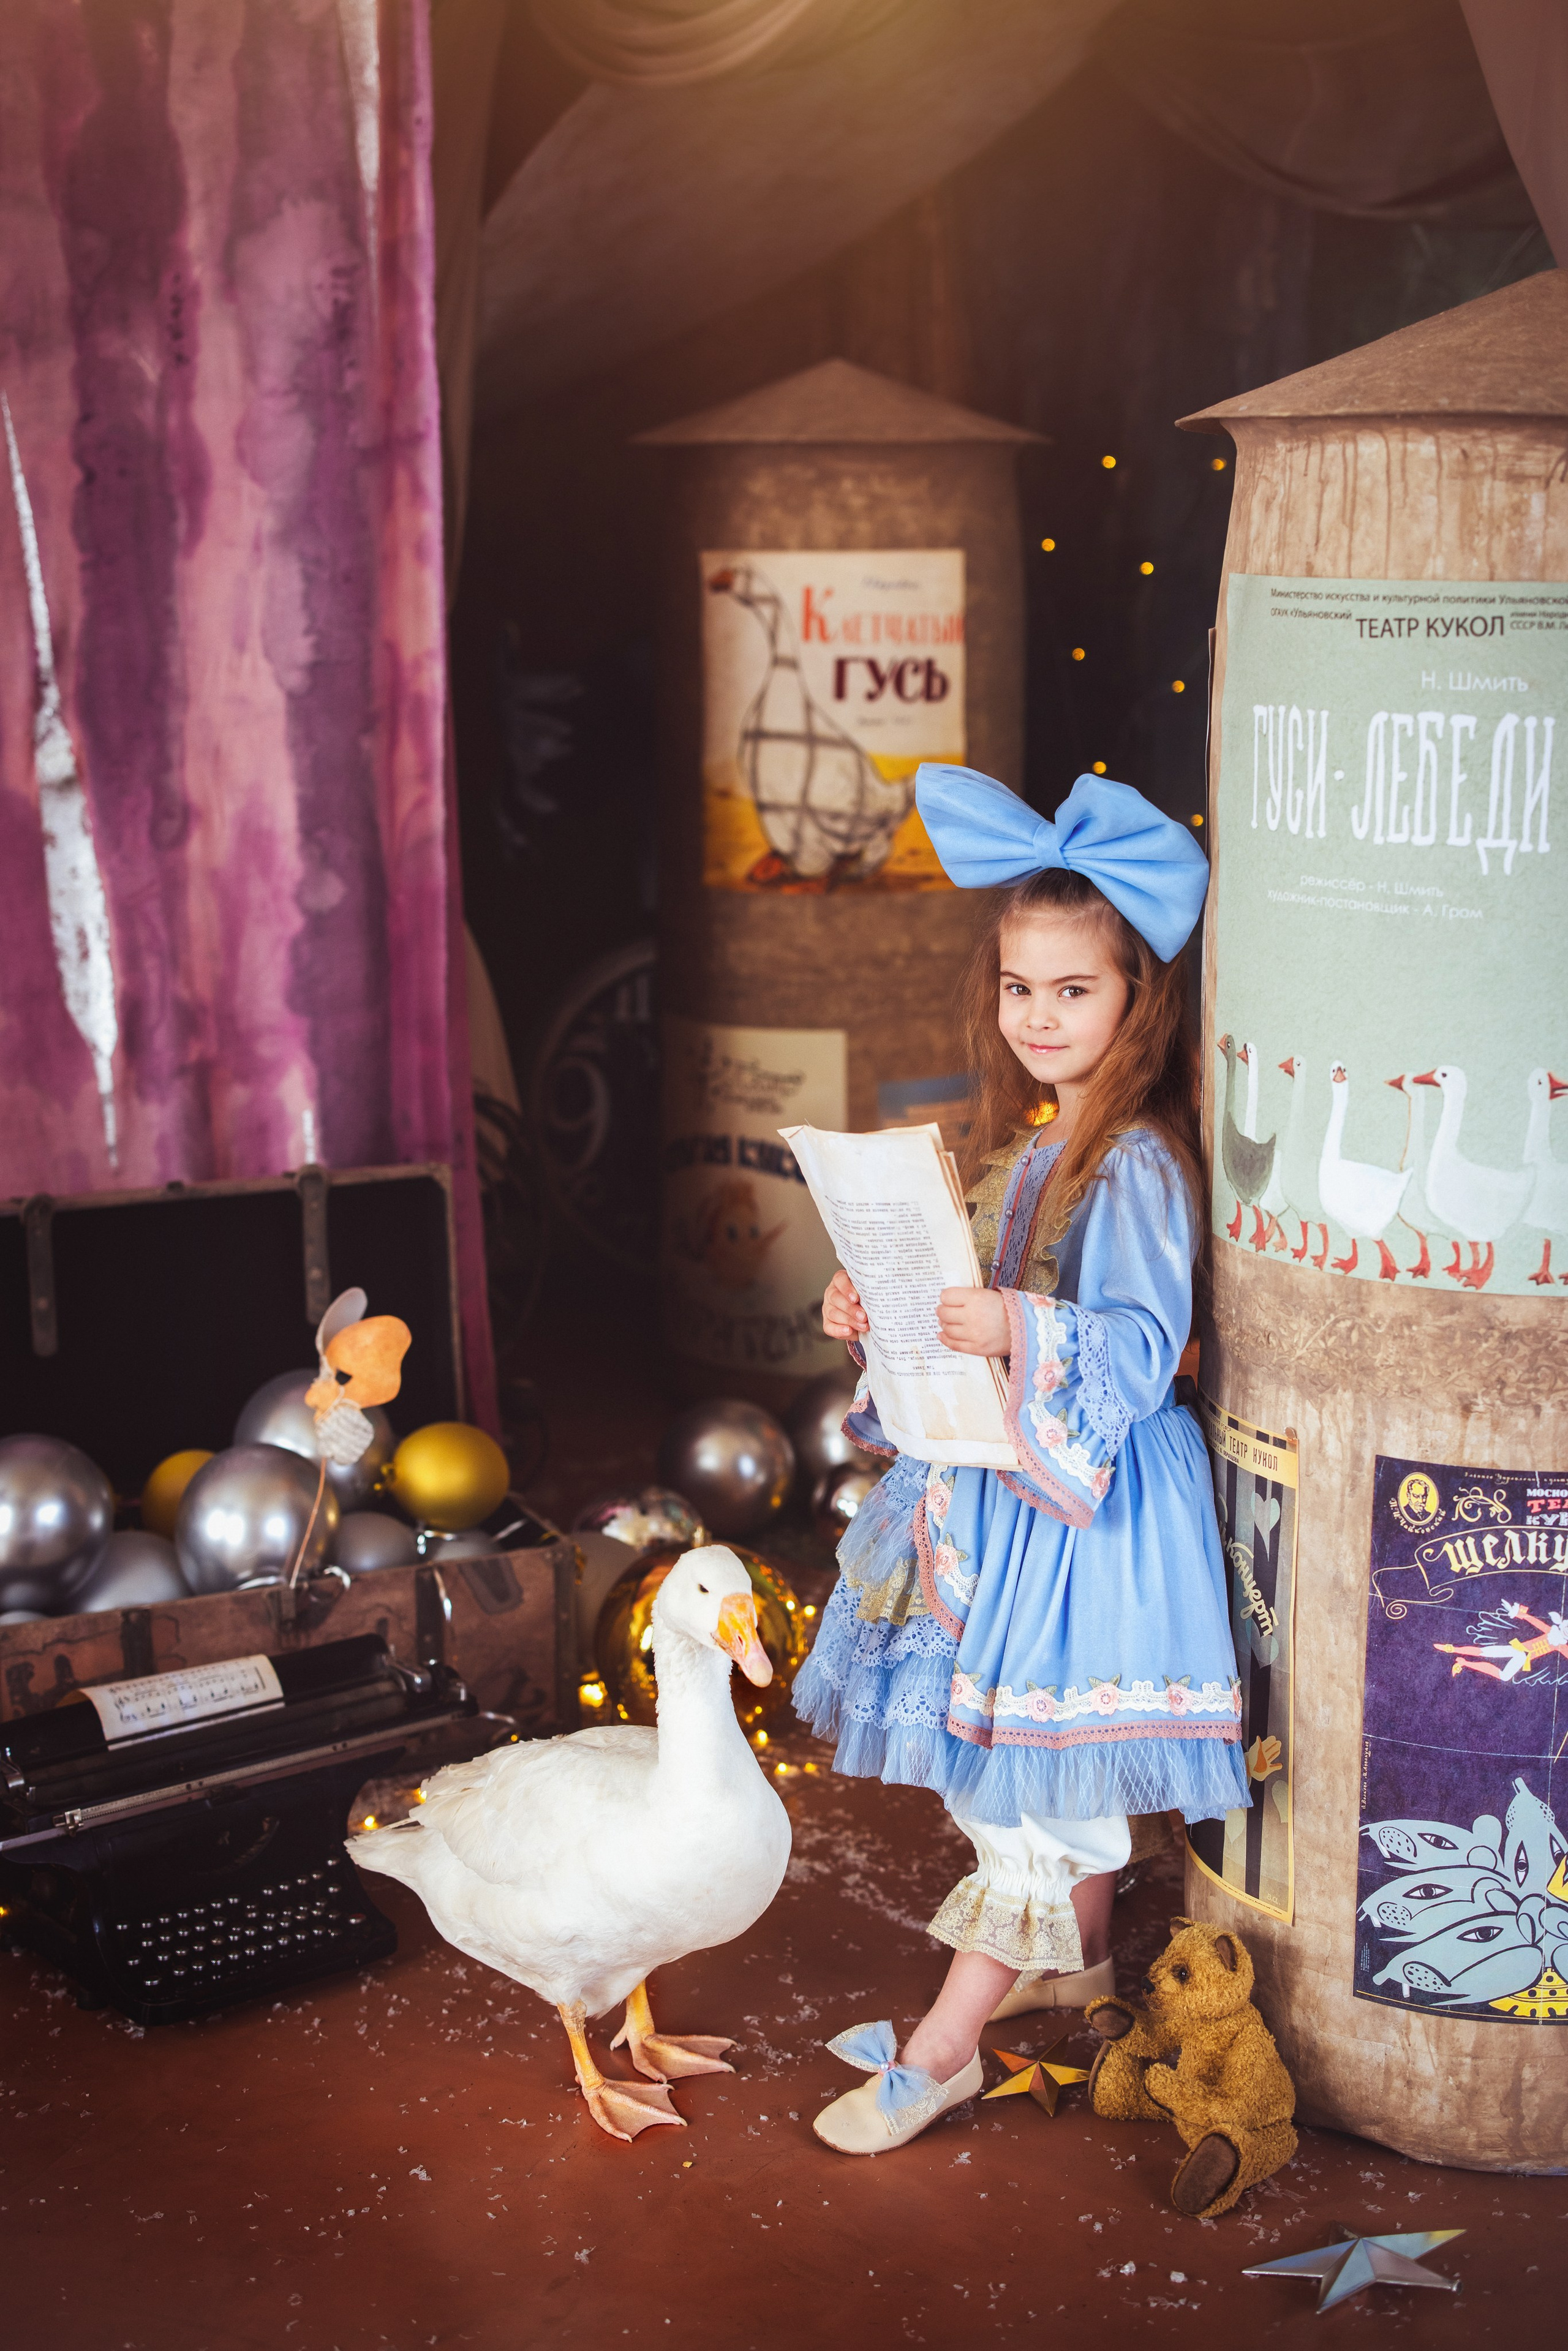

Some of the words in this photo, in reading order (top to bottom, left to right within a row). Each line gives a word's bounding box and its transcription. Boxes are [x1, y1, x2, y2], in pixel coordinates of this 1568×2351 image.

[1270, 588, 1323, 600] Министерство
[1325, 592, 1370, 603] искусства
[1382, 593, 1440, 605] культурной
[1442, 595, 1496, 605] политики
[1355, 617, 1419, 638] ТЕАТР
[1427, 616, 1504, 637] КУКОЛ
[832, 655, 951, 706] ГУСЬ
[1422, 670, 1441, 690] Н.
[1449, 671, 1529, 692] Шмить
[1378, 881, 1390, 894] Н.
[1394, 882, 1444, 897] Шмить
[1267, 889, 1409, 915] художник-постановщик
[1422, 904, 1437, 916] А.
[1442, 905, 1483, 919] Гром
[1223, 1450, 1239, 1463] ОБРАЗЦОВА
[1229, 1436, 1248, 1459] ТЕАТР
[1253, 1447, 1278, 1471] КУКОЛ
[1226, 1536, 1279, 1638] концерт
